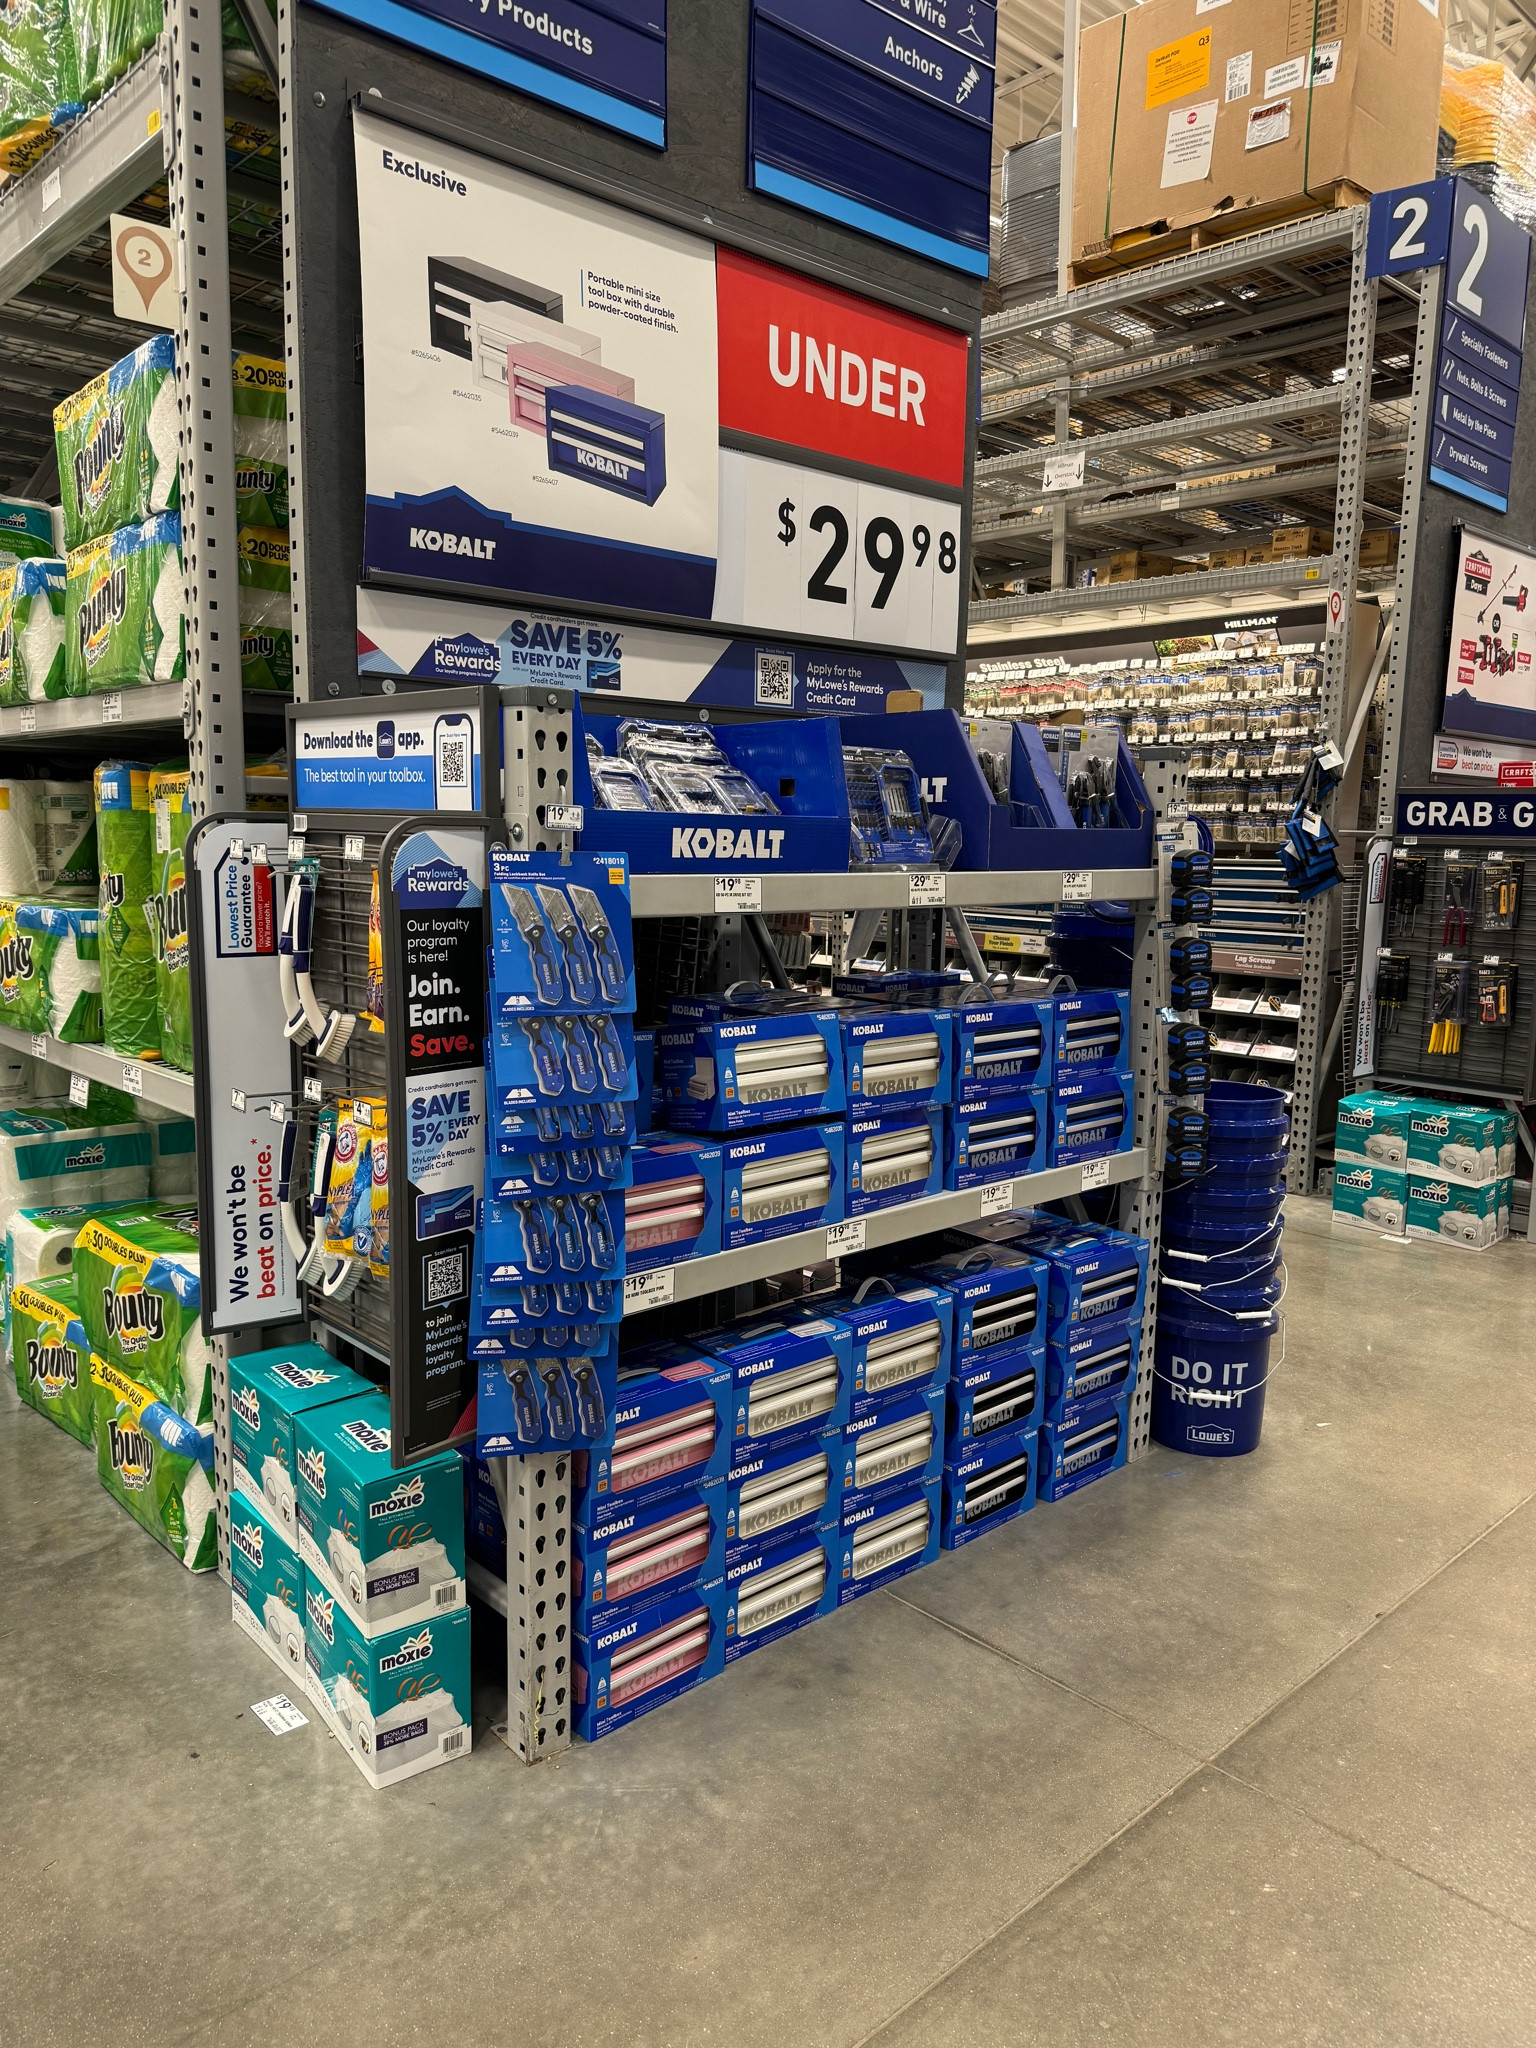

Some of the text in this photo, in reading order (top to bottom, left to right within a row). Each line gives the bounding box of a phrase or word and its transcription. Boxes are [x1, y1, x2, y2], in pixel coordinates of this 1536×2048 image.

[914, 0, 947, 29] Wire
[498, 0, 594, 56] Products
[884, 35, 944, 82] Anchors
[382, 149, 468, 198] Exclusive
[1389, 197, 1430, 261] 2
[137, 248, 152, 267] 2
[1456, 204, 1489, 317] 2
[587, 270, 661, 304] Portable mini size
[587, 285, 676, 321] tool box with durable
[588, 299, 679, 334] powder-coated finish.
[411, 348, 442, 364] #5265406
[1461, 330, 1509, 370] Specialty Fasteners
[768, 323, 927, 428] UNDER
[452, 389, 482, 403] #5462035
[1456, 369, 1507, 408] Nuts, Bolts & Screws
[491, 426, 520, 440] #5462039
[1453, 407, 1497, 440] Metal by the Piece
[576, 448, 629, 481] KOBALT
[1449, 445, 1489, 474] Drywall Screws
[532, 475, 559, 486] #5265407
[409, 526, 496, 561] KOBALT
[1465, 560, 1492, 577] CRAFTSMAN
[1470, 579, 1483, 593] Days
[1333, 601, 1339, 609] 2
[530, 612, 545, 621] Credit
[546, 615, 577, 626] cardholders
[1224, 616, 1278, 629] HILLMAN
[1493, 619, 1500, 628] OR
[510, 619, 581, 655] SAVE
[434, 649, 502, 672] Rewards
[512, 651, 582, 671] EVERY DAY
[806, 662, 862, 679] Apply for the
[979, 656, 1066, 673] Stainless Steel
[530, 669, 557, 679] MyLowe's
[530, 677, 566, 687] Credit Card.
[806, 677, 884, 695] MyLowe's Rewards
[806, 693, 856, 707] Credit Card
[303, 730, 425, 751] Download the app.
[1462, 746, 1472, 757] We
[1485, 749, 1492, 759] be
[1462, 760, 1474, 770] beat
[304, 766, 426, 785] The best tool in your toolbox.
[1406, 800, 1493, 828] GRAB
[1498, 807, 1507, 820] &
[671, 827, 785, 860] KOBALT
[493, 853, 531, 862] KOBALT
[257, 881, 265, 905] price?
[408, 878, 469, 892] Rewards
[225, 864, 240, 949] Lowest Price
[241, 873, 253, 948] Guarantee
[407, 918, 470, 933] Our loyalty
[407, 935, 458, 950] program
[408, 949, 449, 963] is here!
[1235, 954, 1276, 965] Lag Screws
[541, 963, 552, 985] KOBALT
[408, 972, 461, 998] Join.
[409, 1003, 470, 1028] Earn.
[966, 1012, 993, 1024] KOBALT
[720, 1024, 757, 1038] KOBALT
[852, 1023, 884, 1036] KOBALT
[410, 1033, 475, 1057] Save.
[747, 1082, 808, 1105] KOBALT
[867, 1076, 919, 1096] KOBALT
[411, 1089, 471, 1121] SAVE
[448, 1114, 481, 1130] EVERY
[1339, 1112, 1373, 1127] moxie
[1412, 1120, 1448, 1136] moxie
[448, 1128, 470, 1142] DAY
[66, 1154, 104, 1167] moxie
[412, 1146, 476, 1165] MyLowe's Rewards
[730, 1142, 766, 1159] KOBALT
[412, 1159, 455, 1174] Credit Card.
[226, 1164, 250, 1303] We won't be
[257, 1212, 274, 1241] on
[104, 1236, 147, 1266] DOUBLES PLUS
[257, 1245, 276, 1300] beat
[103, 1287, 164, 1339] Bounty
[426, 1313, 453, 1328] to join
[425, 1320, 468, 1341] MyLowe's
[425, 1335, 463, 1354] Rewards
[27, 1340, 78, 1389] Bounty
[425, 1350, 455, 1366] loyalty
[274, 1361, 315, 1388] moxie
[425, 1360, 466, 1380] program.
[738, 1358, 775, 1379] KOBALT
[1171, 1355, 1249, 1386] DO IT
[1171, 1384, 1247, 1409] RIGHT
[1191, 1428, 1230, 1442] LOWE'S
[371, 1489, 424, 1514] moxie
[593, 1516, 635, 1541] KOBALT
[373, 1571, 416, 1588] BONUS PACK
[386, 1582, 404, 1591] MORE
[404, 1578, 416, 1586] BAGS
[597, 1622, 638, 1650] KOBALT
[381, 1645, 433, 1671] moxie
